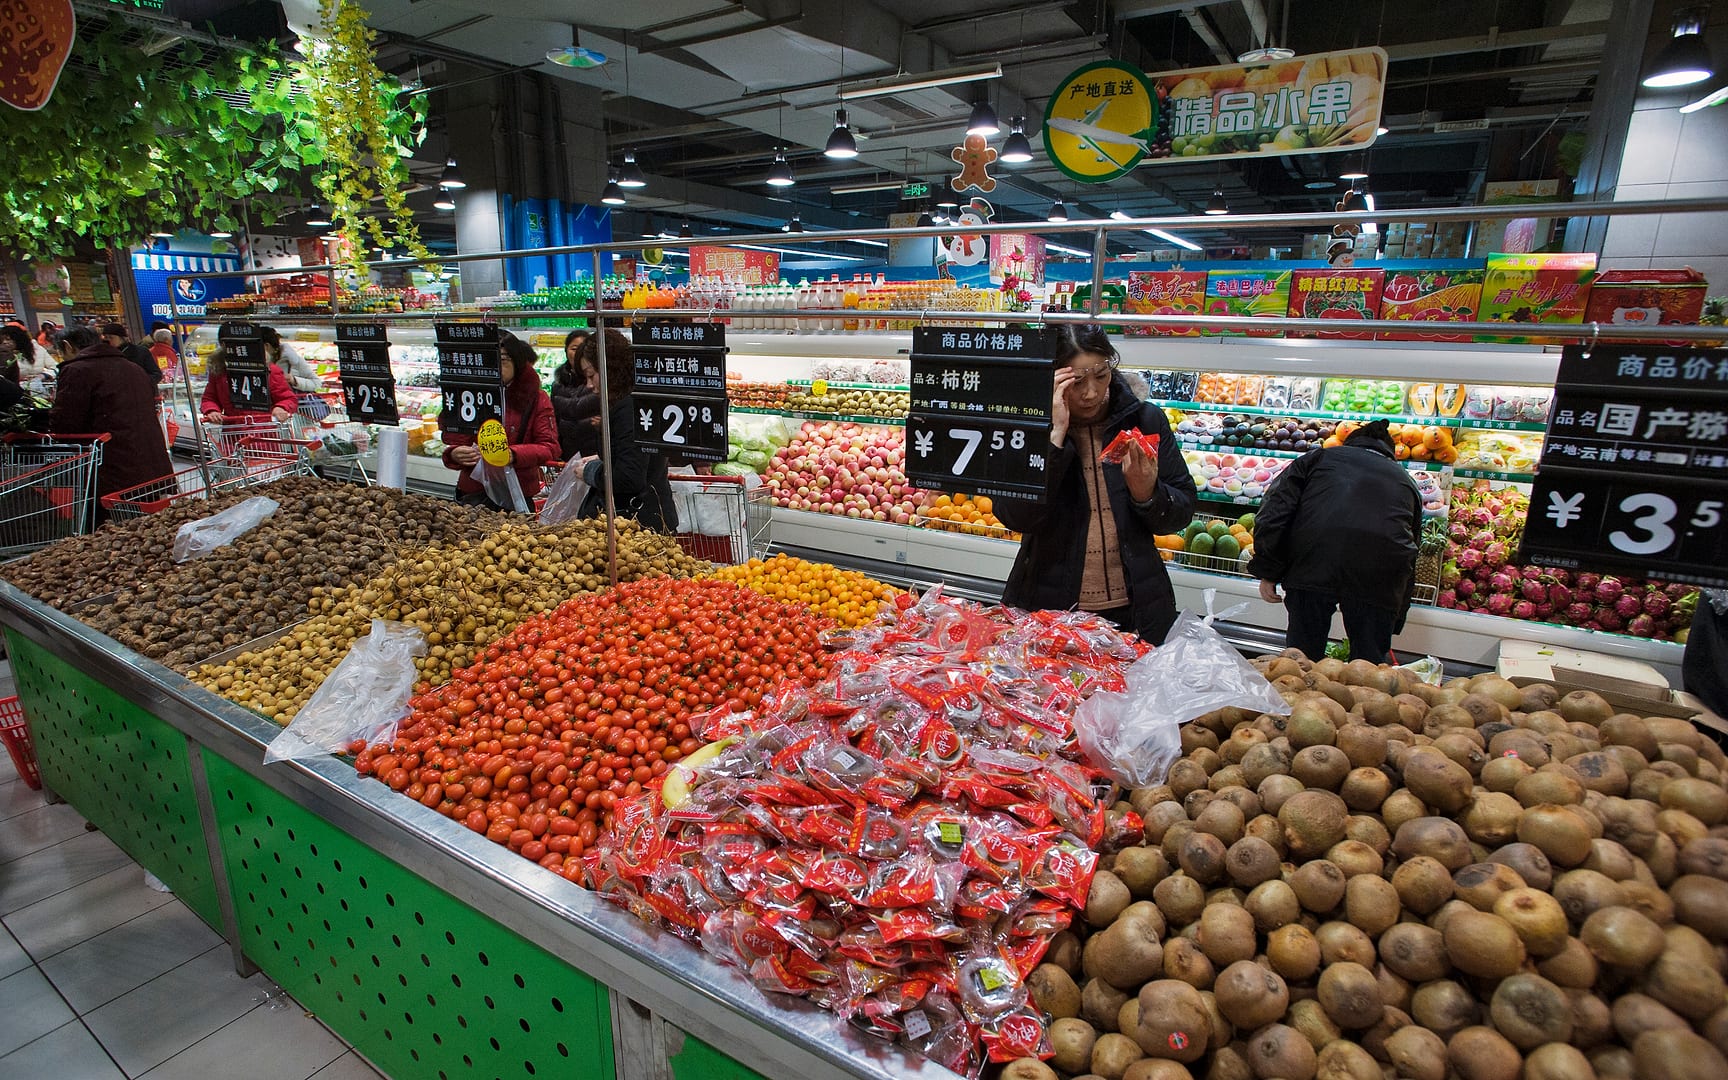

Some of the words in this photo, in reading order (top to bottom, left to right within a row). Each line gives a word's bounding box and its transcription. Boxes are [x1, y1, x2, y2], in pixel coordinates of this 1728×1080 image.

[1070, 79, 1134, 99] 产地直送
[1173, 81, 1352, 136] 精品水果
[1129, 274, 1193, 302] 高原红
[1385, 273, 1434, 300] Apple
[1492, 280, 1581, 305] 高档水果
[448, 326, 485, 338] 商品价格牌
[651, 326, 705, 340] 商品价格牌
[942, 331, 1024, 351] 商品价格牌
[653, 356, 699, 374] 小西红柿
[941, 369, 981, 391] 柿饼
[346, 386, 356, 404] ¥
[445, 391, 455, 411] ¥
[639, 408, 653, 431] ¥
[914, 429, 934, 458] ¥
[949, 428, 1026, 476] 7.58
[1029, 454, 1045, 471] 500g
[1546, 490, 1585, 529] ¥
[985, 835, 1018, 860] 柿饼
